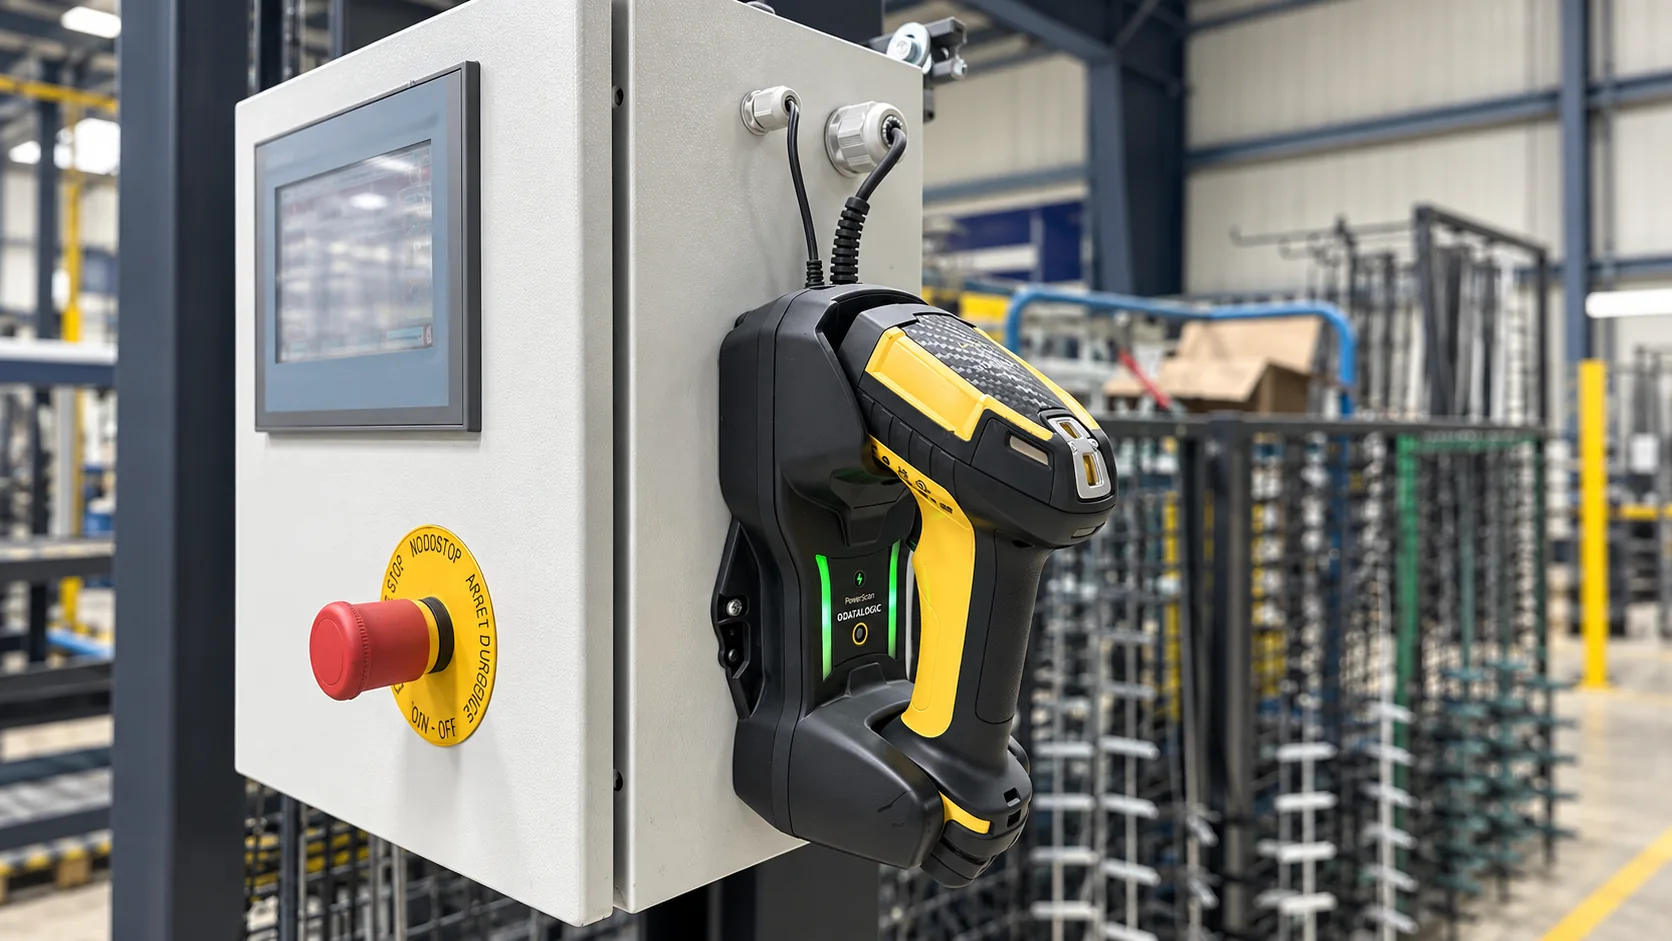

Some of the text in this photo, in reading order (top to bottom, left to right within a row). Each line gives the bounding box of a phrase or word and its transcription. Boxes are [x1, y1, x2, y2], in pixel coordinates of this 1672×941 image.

[387, 554, 404, 593] STOP
[465, 573, 489, 628] ARRET
[845, 592, 875, 605] PowerScan
[438, 717, 456, 740] OFF
